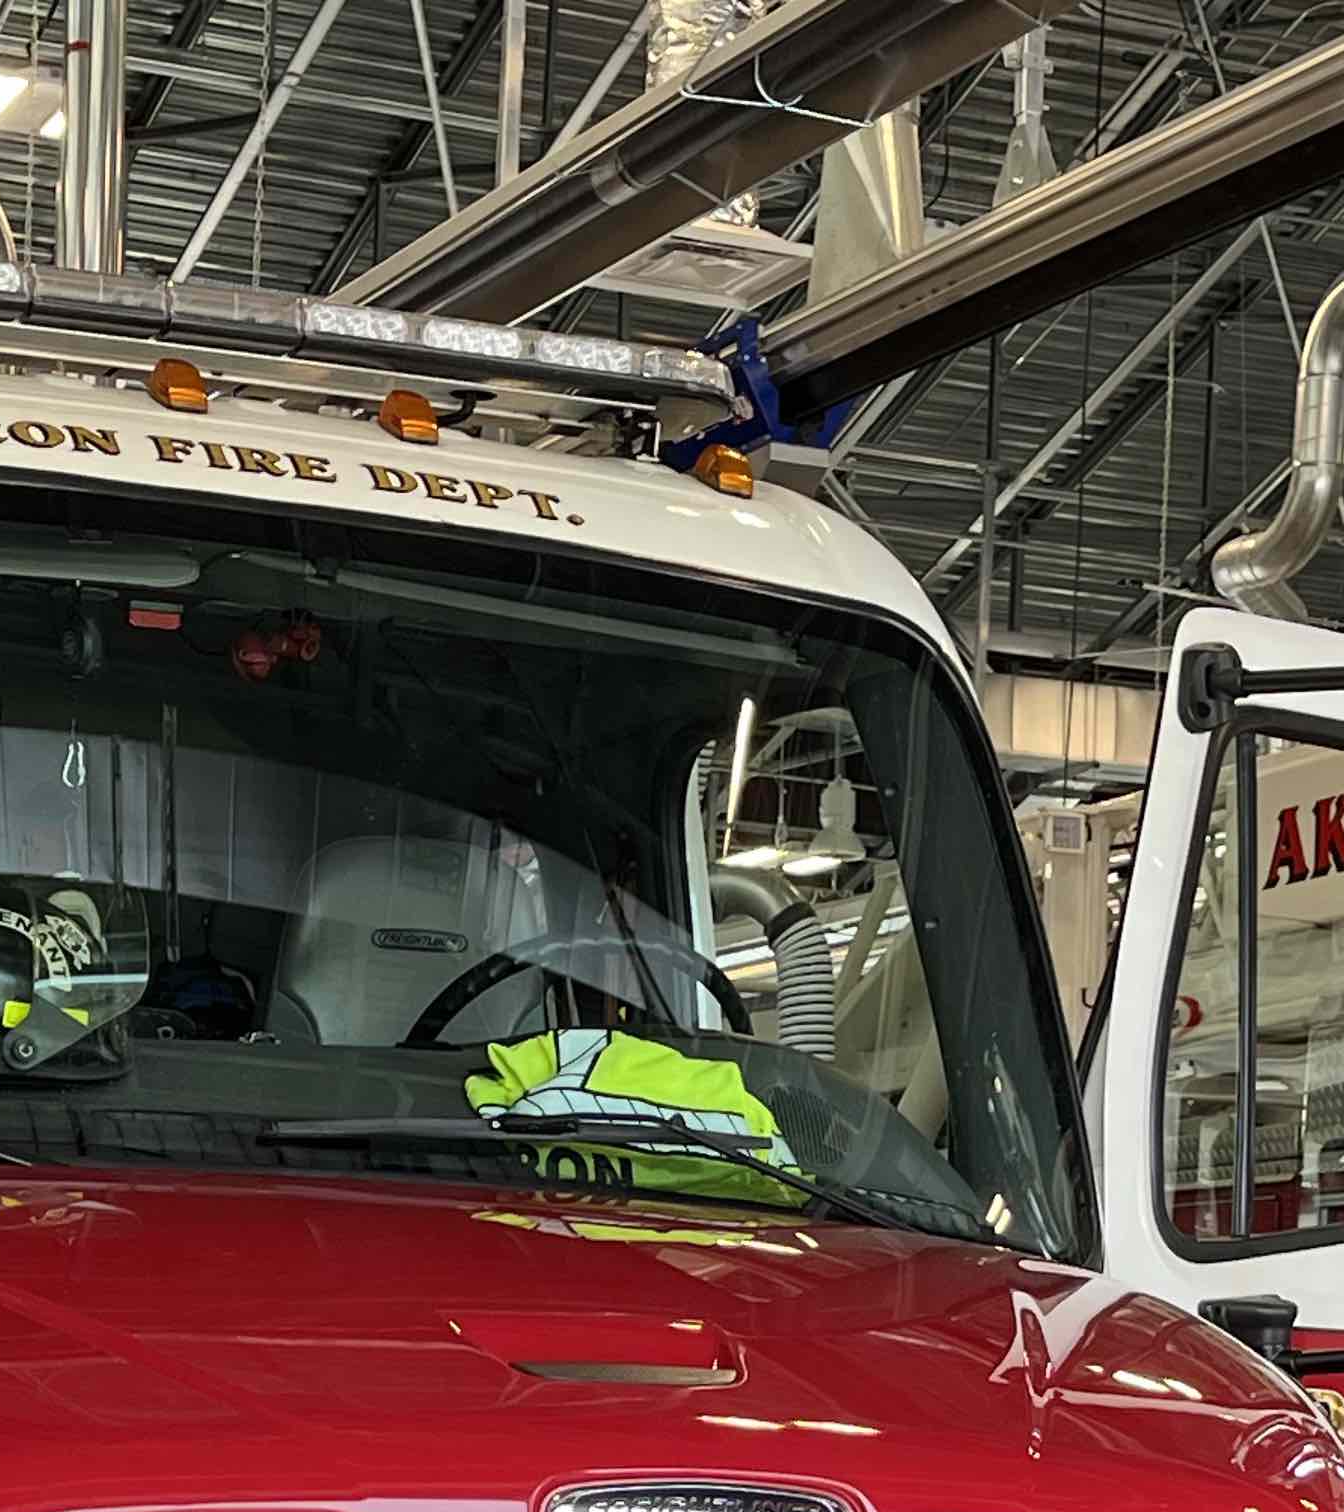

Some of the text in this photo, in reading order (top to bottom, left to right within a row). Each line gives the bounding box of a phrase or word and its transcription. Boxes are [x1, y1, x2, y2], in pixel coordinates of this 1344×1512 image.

[146, 434, 338, 484] FIRE
[360, 463, 586, 526] DEPT.
[513, 1143, 635, 1190] RON
